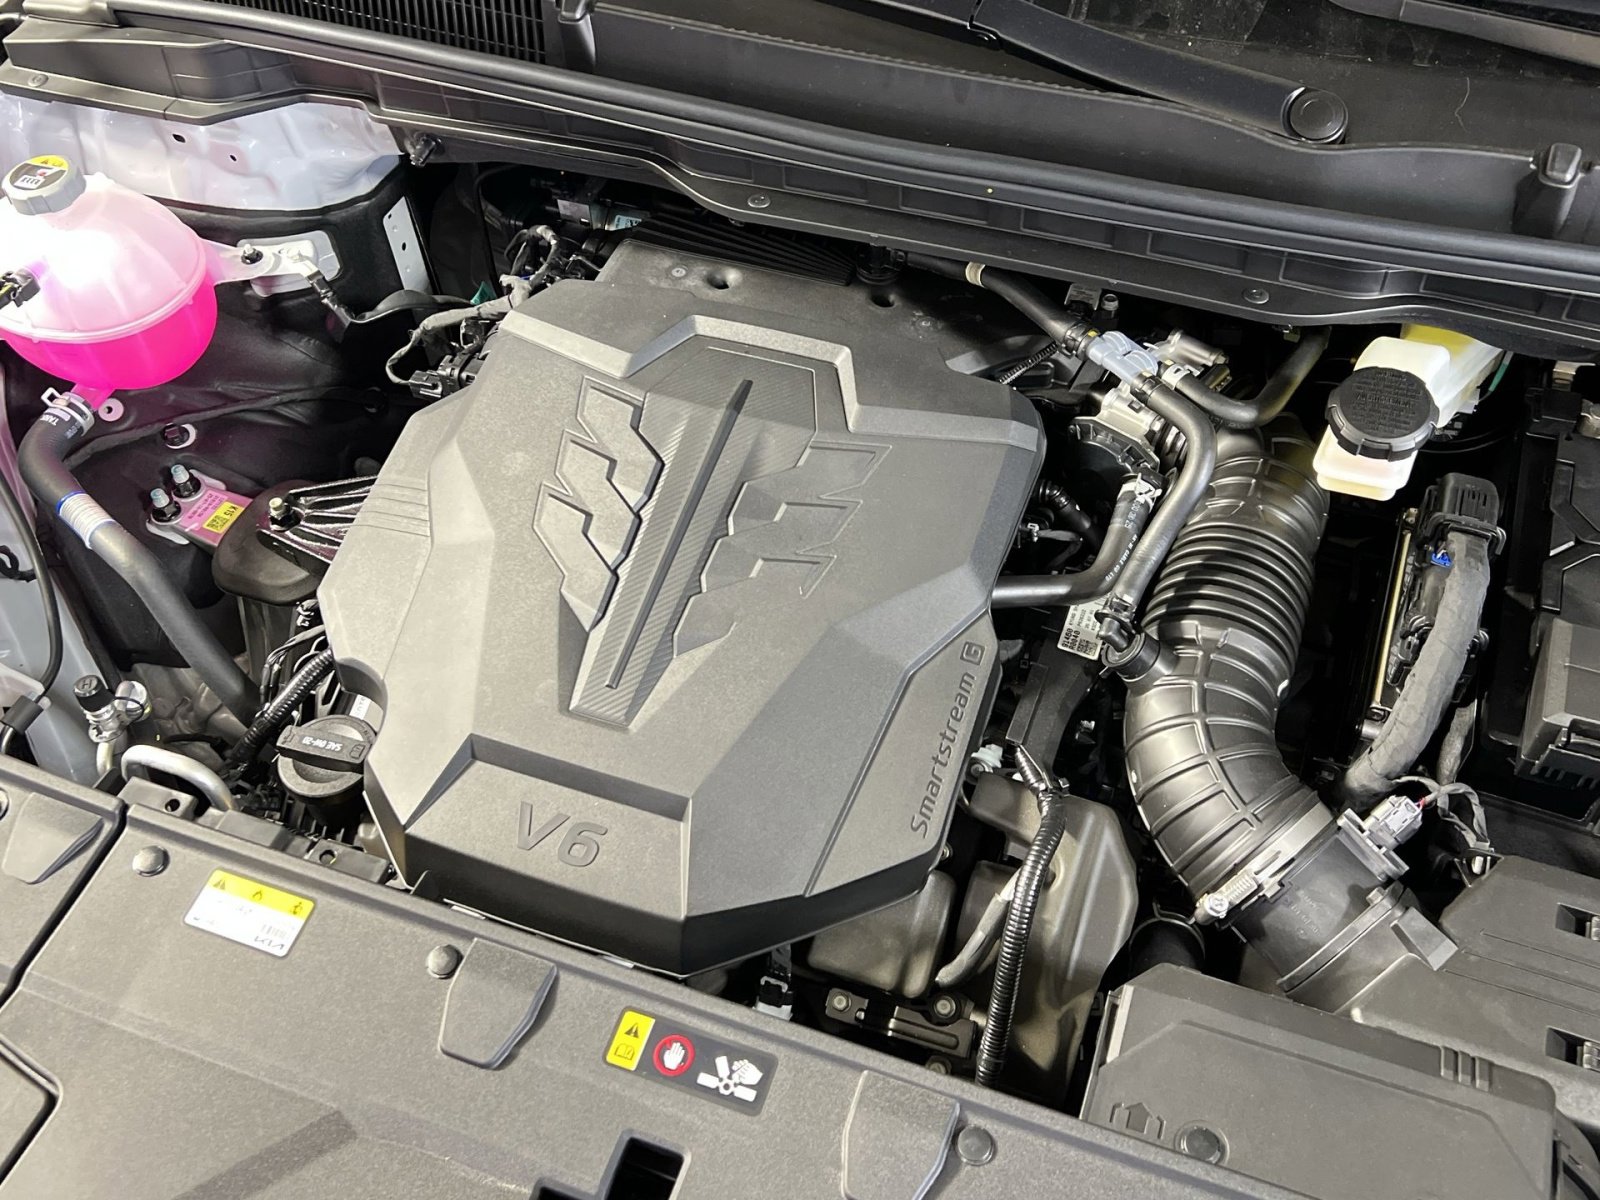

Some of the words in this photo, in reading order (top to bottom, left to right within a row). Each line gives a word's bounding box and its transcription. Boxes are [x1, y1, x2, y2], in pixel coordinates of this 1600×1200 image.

[326, 741, 343, 752] SAE
[911, 673, 977, 839] Smartstream
[960, 641, 985, 666] G
[517, 800, 609, 868] V6
[254, 935, 286, 950] KIA
